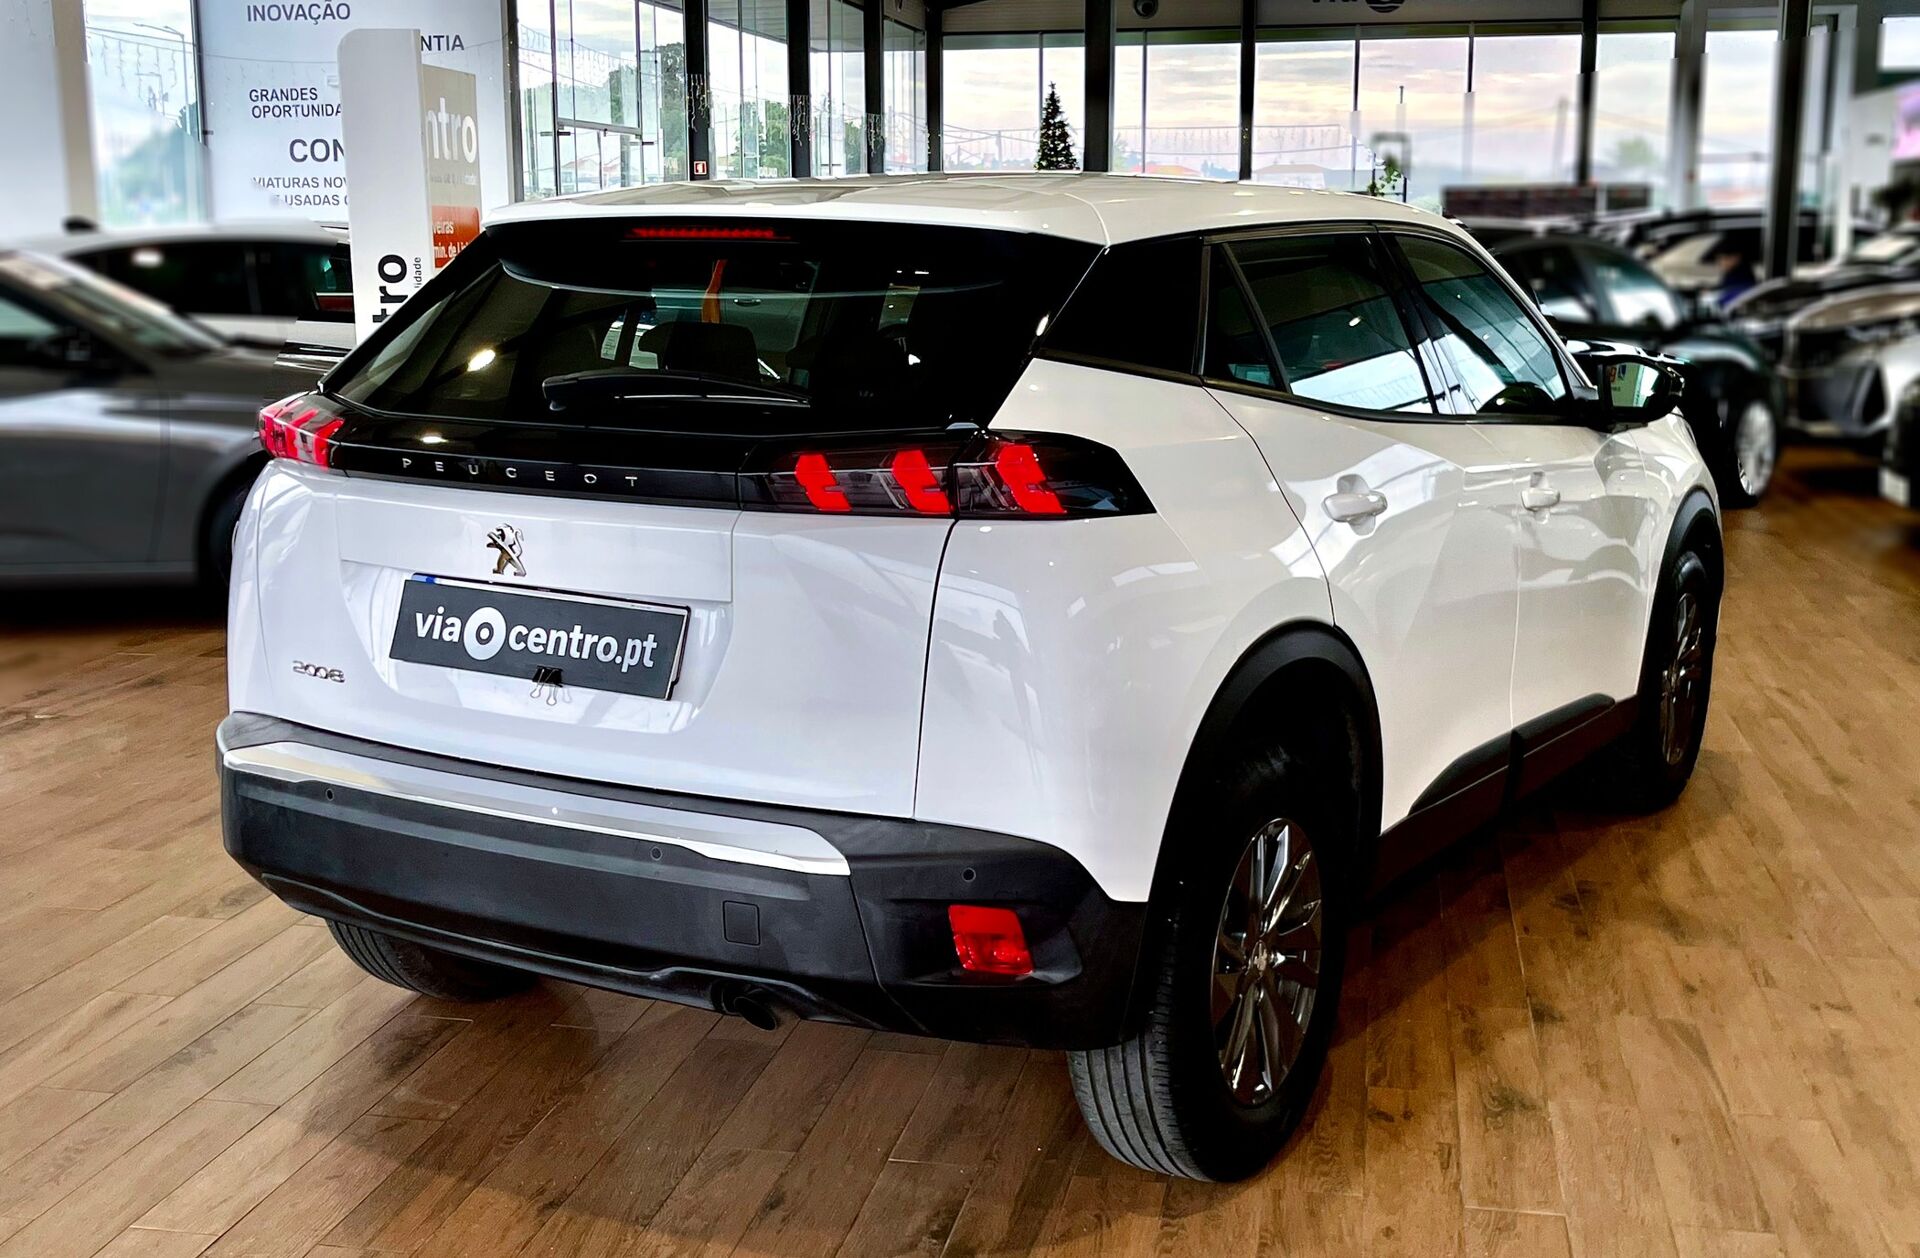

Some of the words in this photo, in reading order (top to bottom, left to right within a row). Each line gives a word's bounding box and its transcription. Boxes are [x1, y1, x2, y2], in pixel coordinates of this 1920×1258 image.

[247, 0, 351, 25] INOVAÇÃO
[420, 34, 464, 51] NTIA
[249, 87, 318, 102] GRANDES
[284, 194, 340, 206] USADAS
[402, 458, 637, 487] PEUGEOT
[292, 660, 345, 683] 2008
